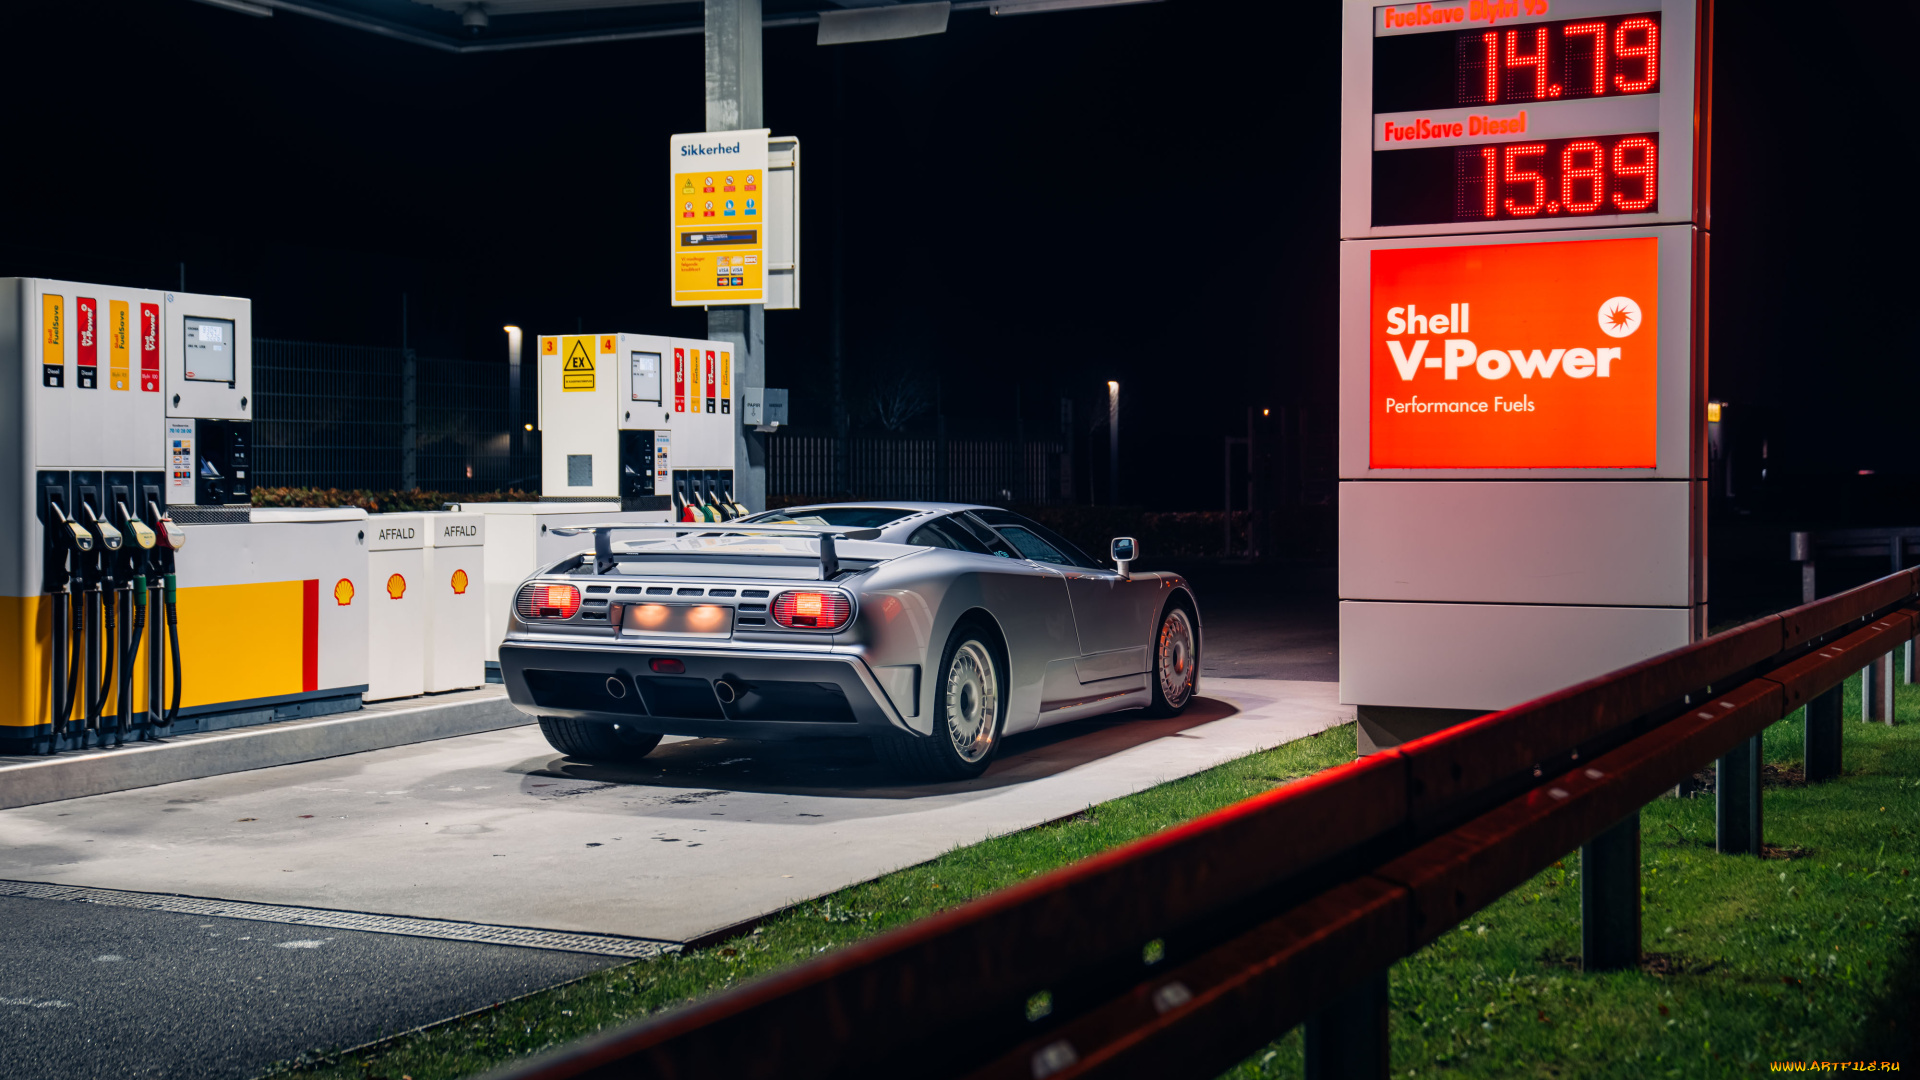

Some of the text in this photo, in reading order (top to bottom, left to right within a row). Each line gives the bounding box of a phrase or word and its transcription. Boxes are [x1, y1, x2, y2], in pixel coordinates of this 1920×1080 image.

[1385, 3, 1465, 29] FuelSave
[1523, 0, 1549, 16] 95
[1483, 18, 1660, 103] 14.79
[1384, 110, 1527, 142] FuelSave Diesel
[681, 142, 740, 157] Sikkerhed
[1482, 137, 1656, 217] 15.89
[1385, 302, 1470, 336] Shell
[148, 313, 156, 351] V-Power
[546, 341, 553, 352] 3
[604, 339, 612, 350] 4
[572, 357, 585, 368] EX
[1385, 338, 1622, 381] V-Power
[1386, 394, 1535, 414] Performance Fuels
[379, 528, 414, 540] AFFALD
[443, 526, 477, 538] AFFALD
